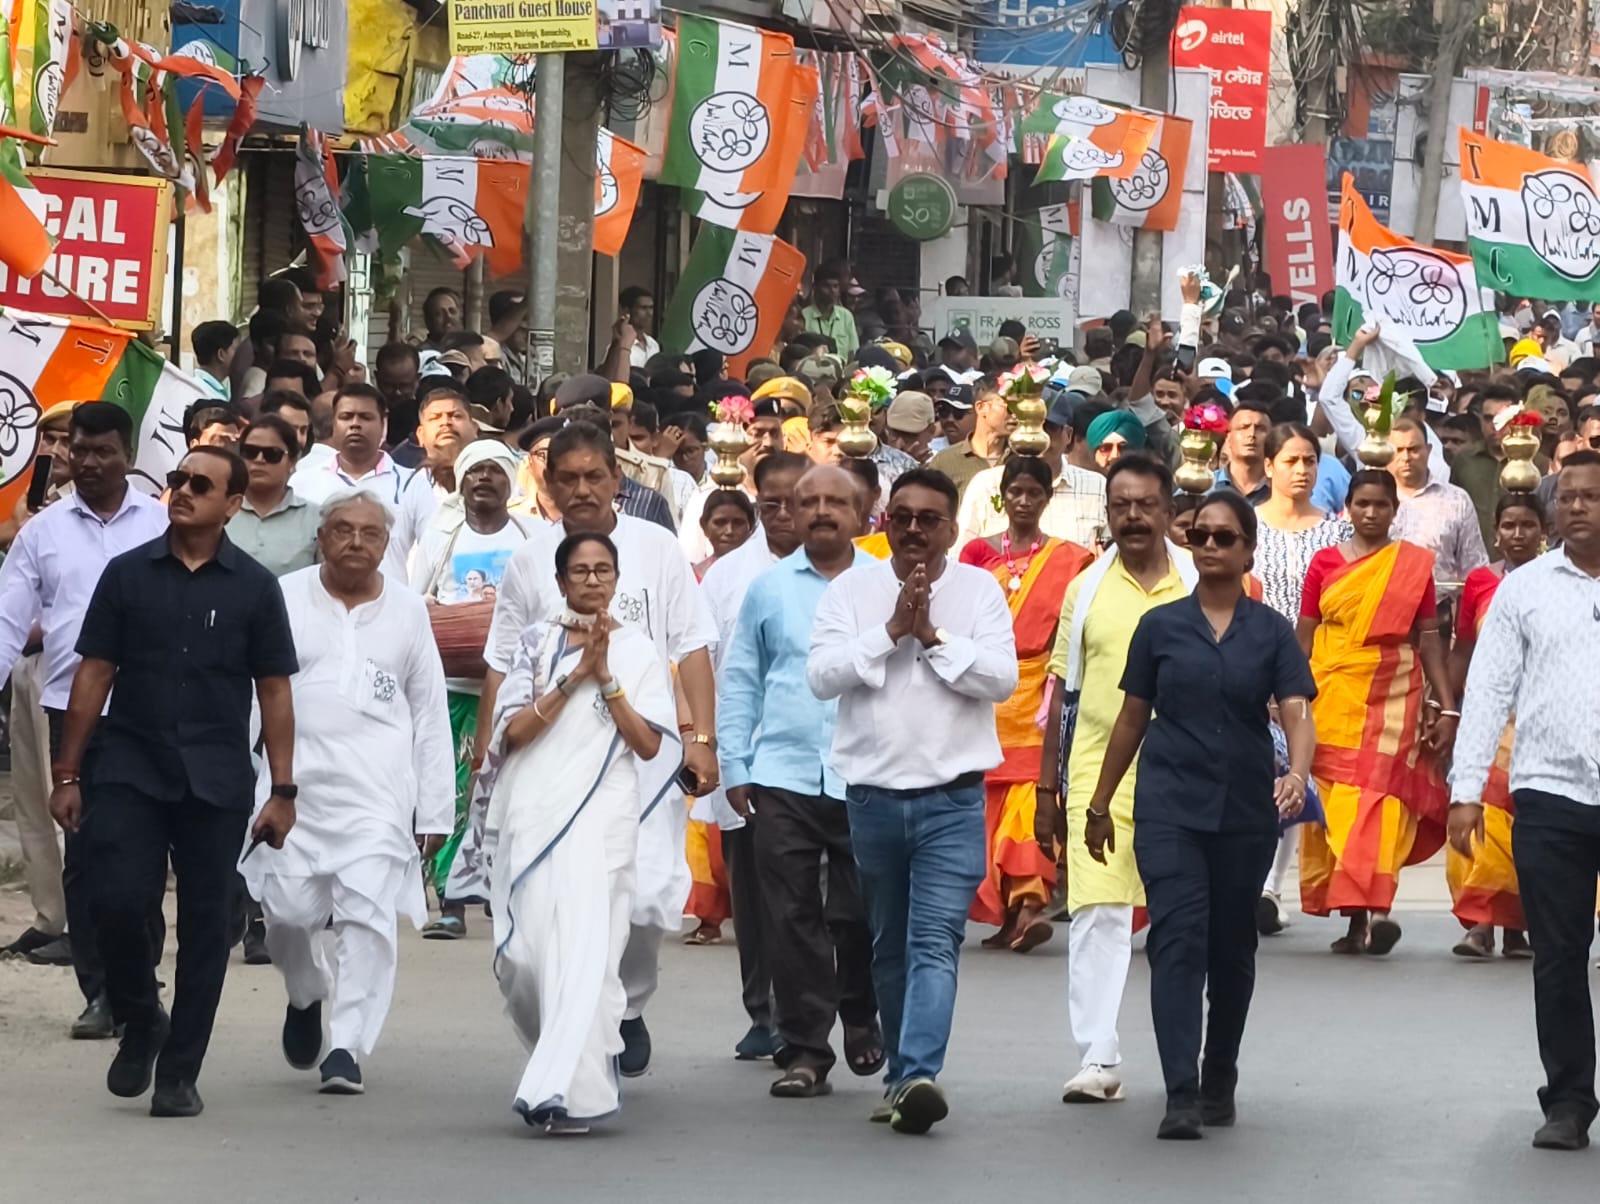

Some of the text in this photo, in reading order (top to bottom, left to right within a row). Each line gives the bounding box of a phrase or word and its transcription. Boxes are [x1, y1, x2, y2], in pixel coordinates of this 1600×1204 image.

[455, 0, 592, 20] Panchvati Guest House
[1211, 30, 1245, 45] airtel
[1464, 142, 1482, 180] T
[1470, 194, 1501, 233] M
[1489, 246, 1513, 286] C
[1028, 316, 1061, 329] ROSS
